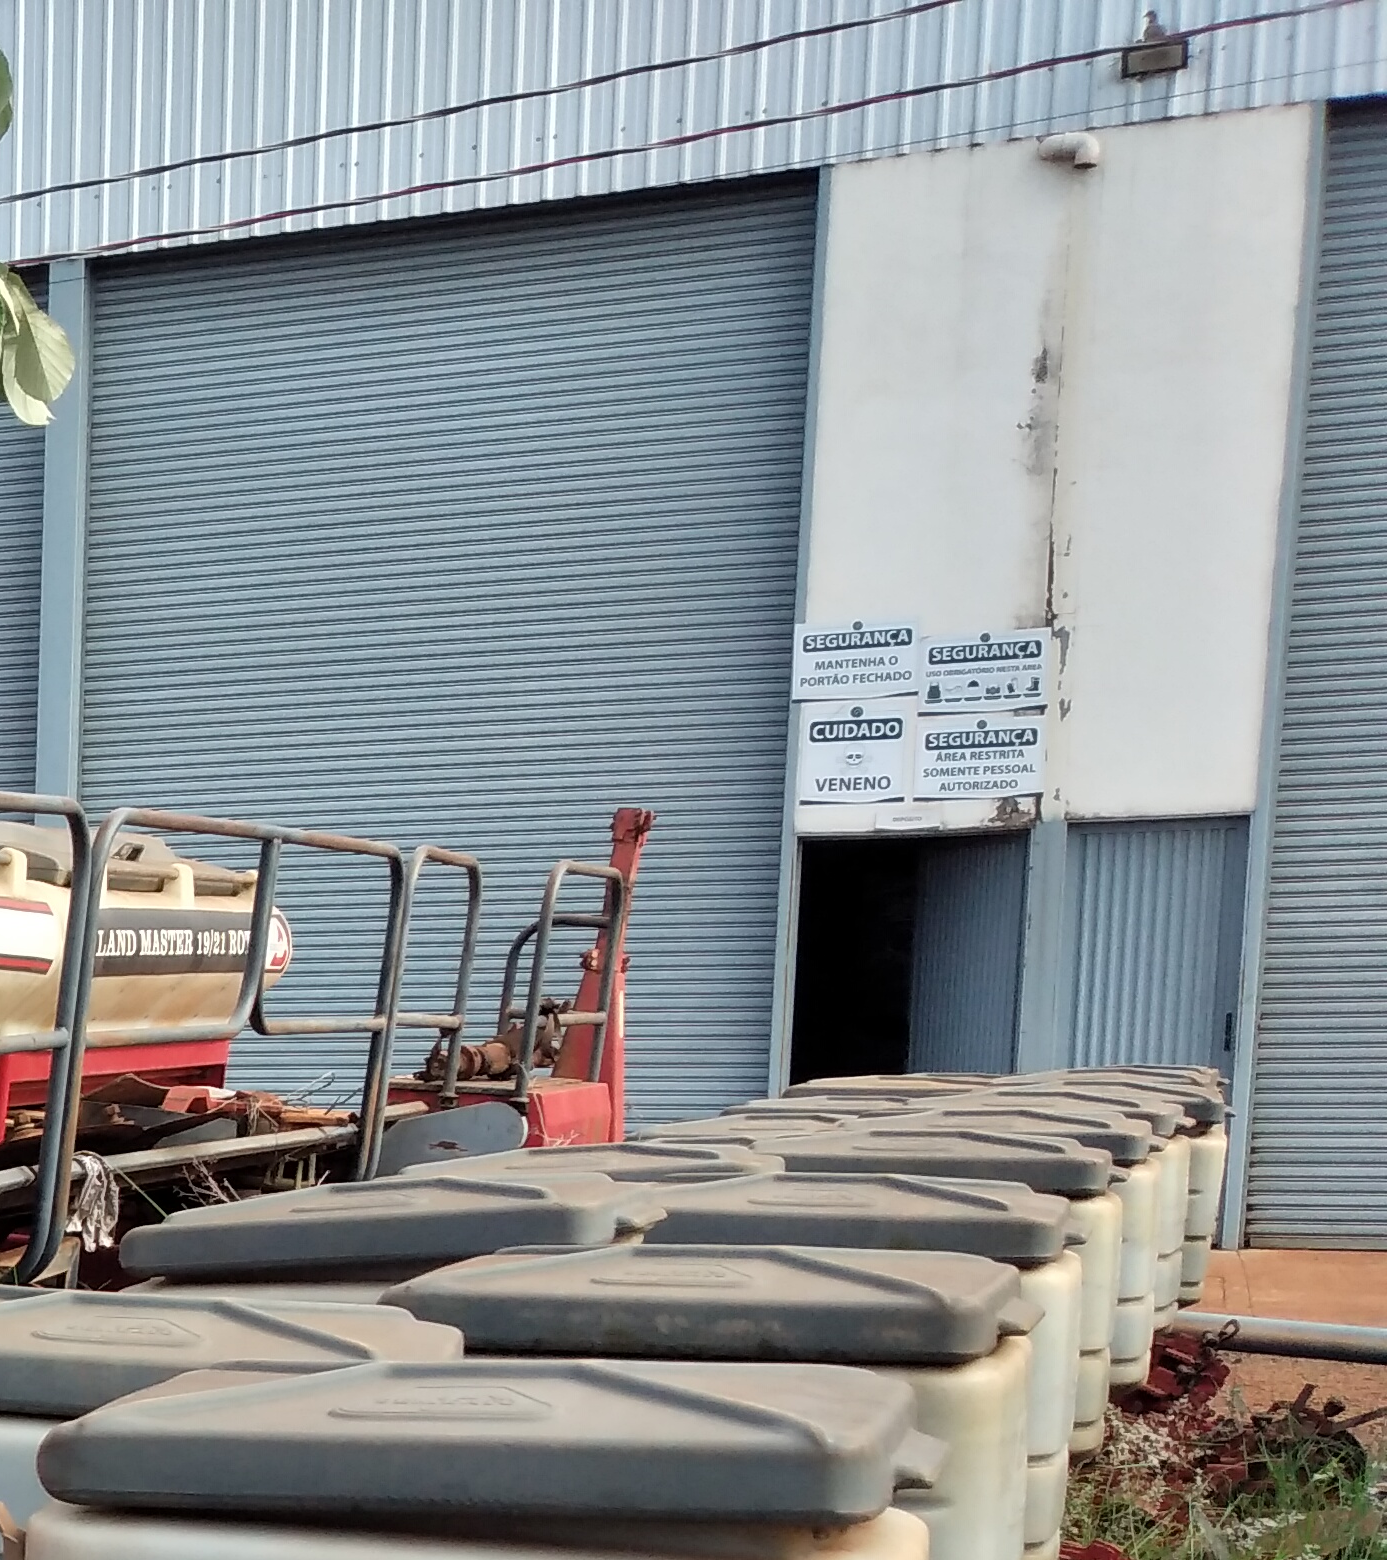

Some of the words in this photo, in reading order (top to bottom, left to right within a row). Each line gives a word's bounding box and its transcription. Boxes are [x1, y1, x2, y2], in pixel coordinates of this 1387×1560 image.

[805, 628, 910, 650] SEGURANÇA
[931, 641, 1039, 662] SEGURANÇA
[814, 657, 885, 671] MANTENHA
[888, 655, 899, 667] O
[800, 673, 850, 688] PORTÃO
[852, 670, 913, 685] FECHADO
[812, 721, 900, 740] CUIDADO
[928, 728, 1035, 749] SEGURANÇA
[935, 749, 967, 762] ÁREA
[969, 749, 1025, 761] RESTRITA
[923, 766, 981, 778] SOMENTE
[983, 764, 1037, 776] PESSOAL
[815, 775, 892, 793] VENENO
[939, 779, 1019, 792] AUTORIZADO
[96, 929, 137, 957] LAND
[138, 928, 193, 957] MASTER
[196, 930, 226, 958] 19/21
